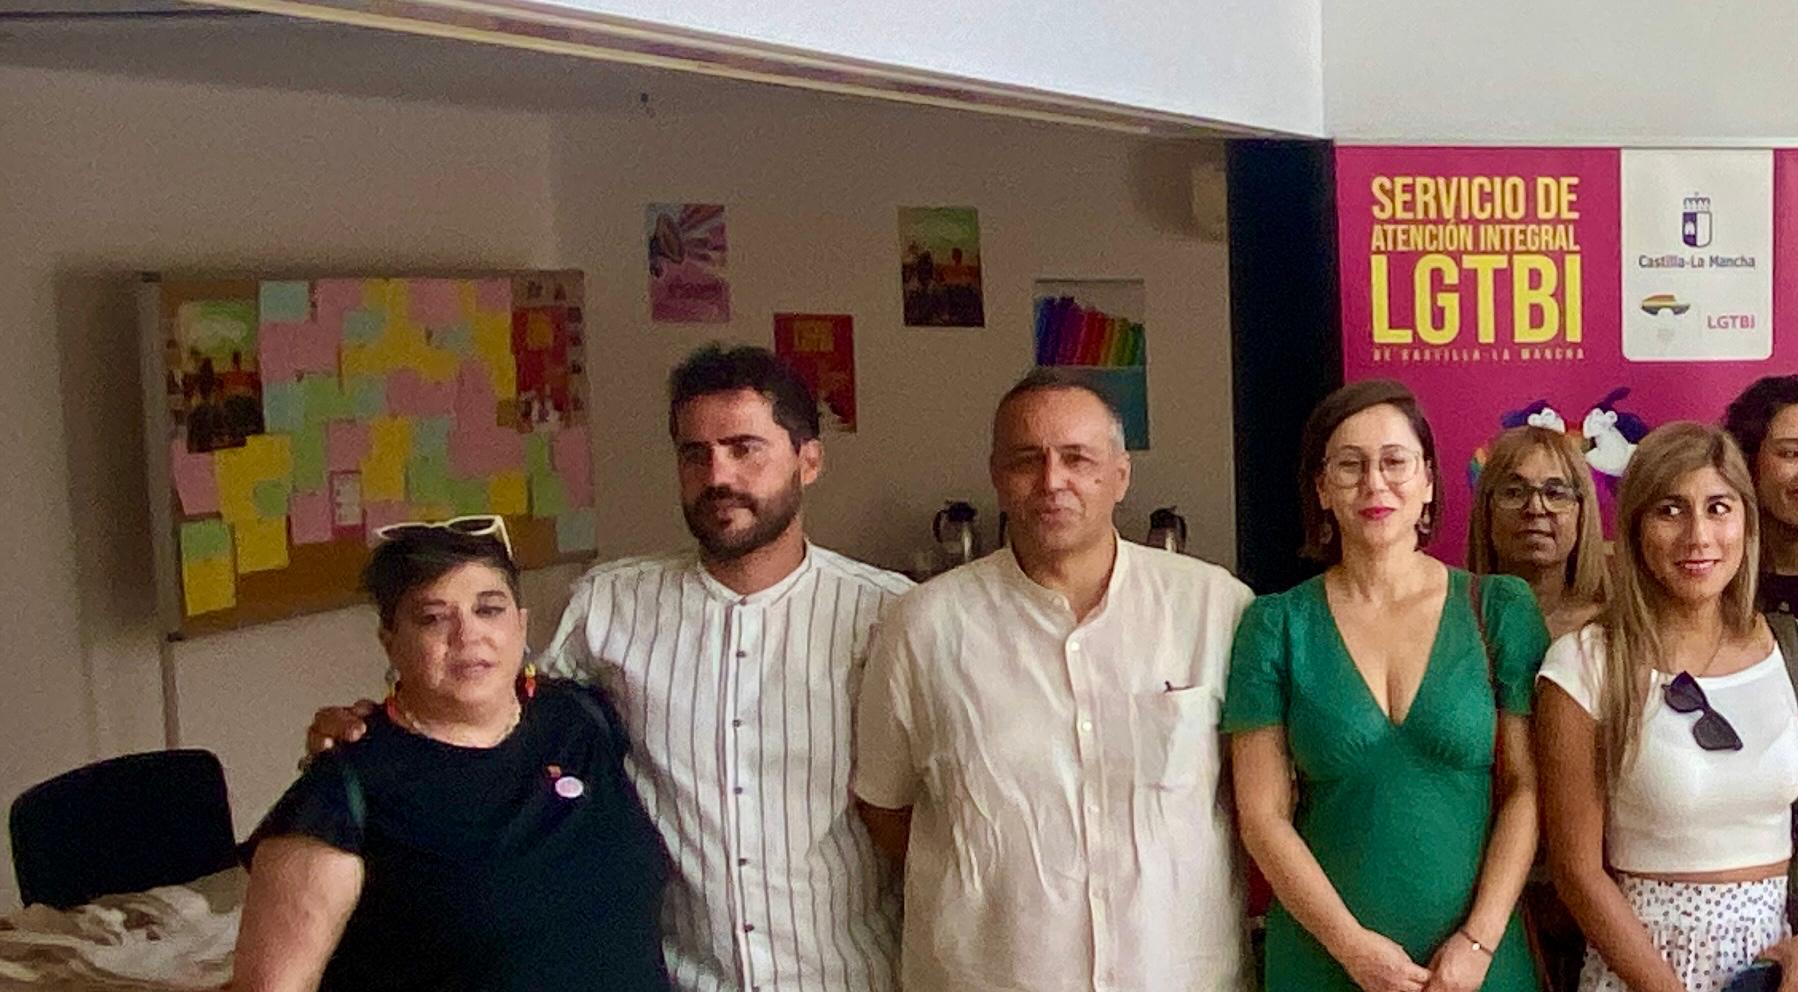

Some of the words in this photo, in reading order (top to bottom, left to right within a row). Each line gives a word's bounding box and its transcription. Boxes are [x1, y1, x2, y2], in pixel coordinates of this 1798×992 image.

[1371, 176, 1526, 220] SERVICIO
[1536, 176, 1580, 220] DE
[1371, 220, 1473, 251] ATENCIÓN
[1479, 223, 1581, 251] INTEGRAL
[1638, 254, 1705, 269] Castilla-La
[1709, 254, 1756, 269] Mancha
[1370, 252, 1584, 345] LGTBI
[1707, 314, 1756, 329] LGTBI
